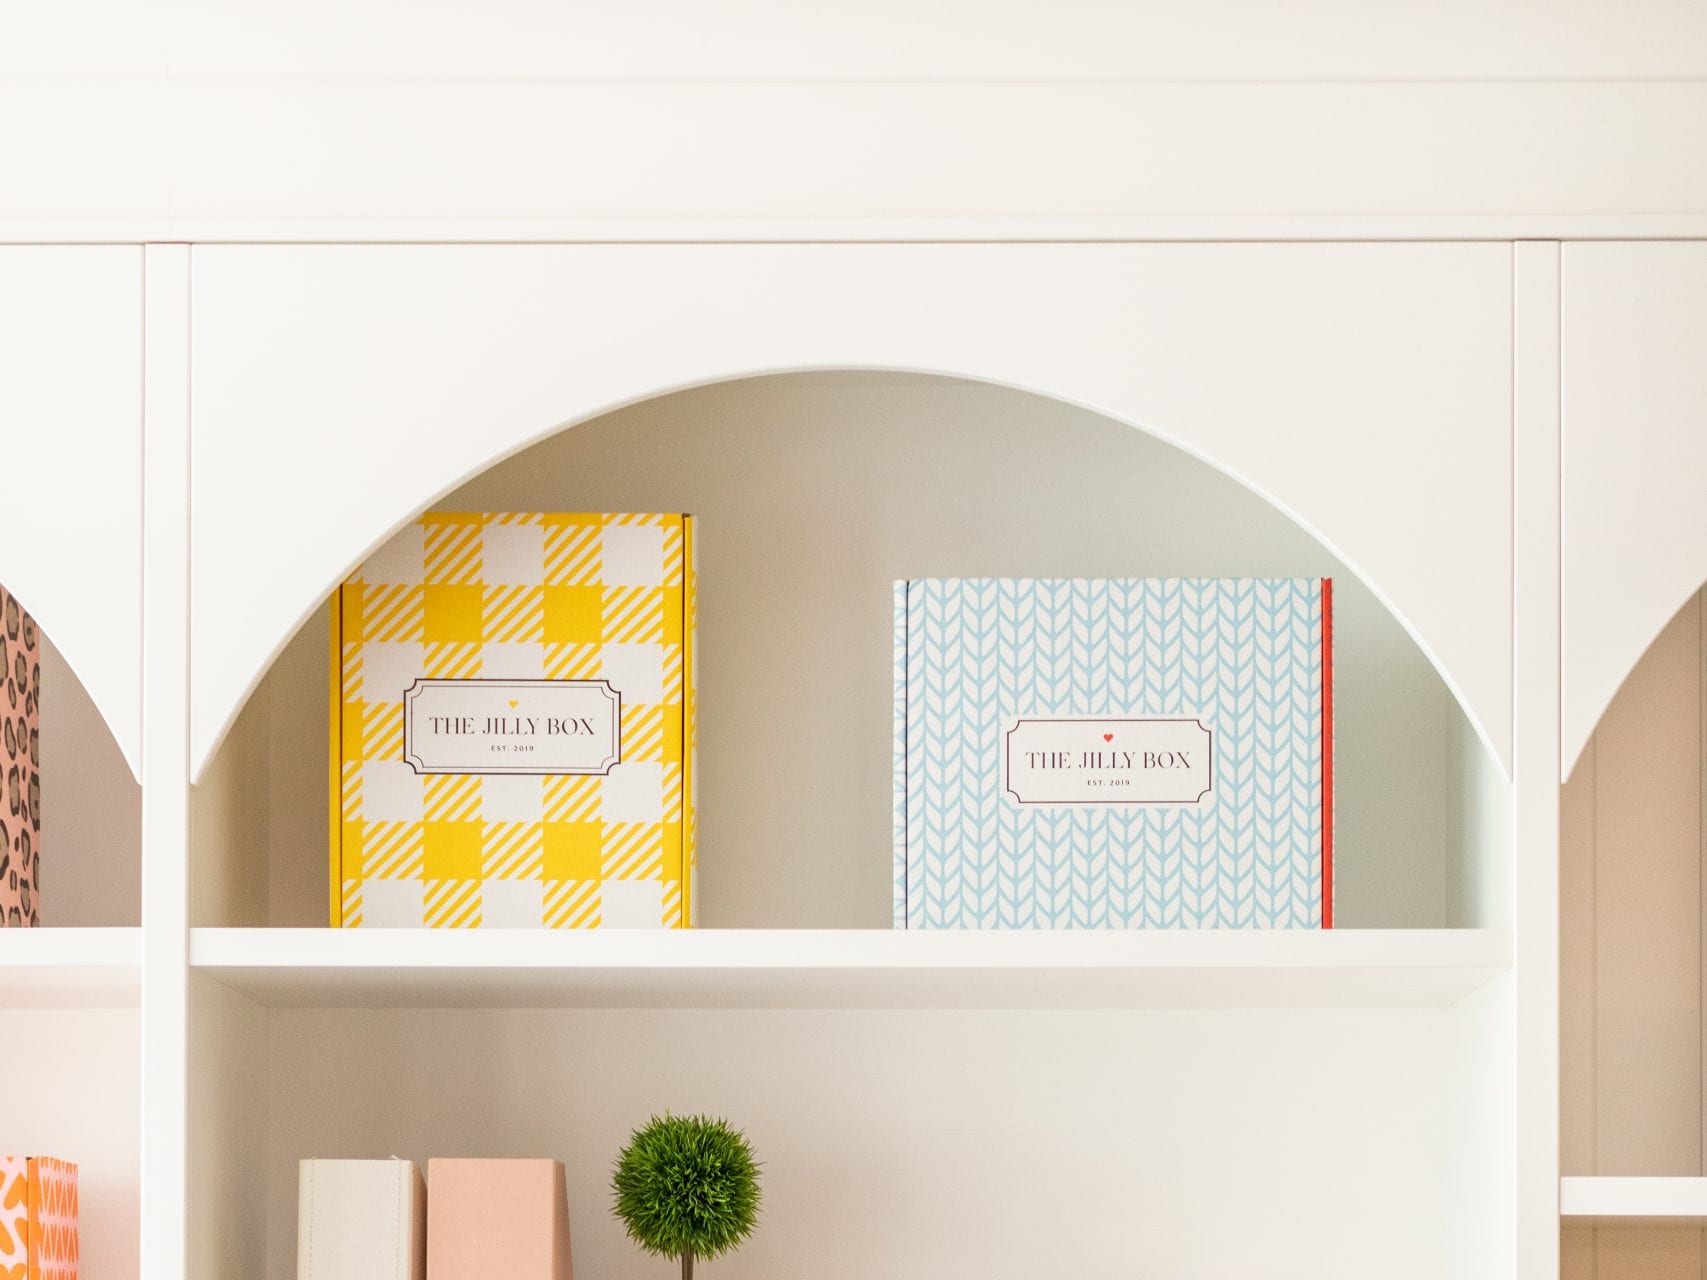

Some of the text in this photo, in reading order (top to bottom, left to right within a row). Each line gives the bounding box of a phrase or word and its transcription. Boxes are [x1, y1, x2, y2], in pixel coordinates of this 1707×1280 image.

[429, 717, 596, 736] THE JILLY BOX
[1025, 751, 1191, 769] THE JILLY BOX
[1087, 779, 1131, 787] EST. 2019
